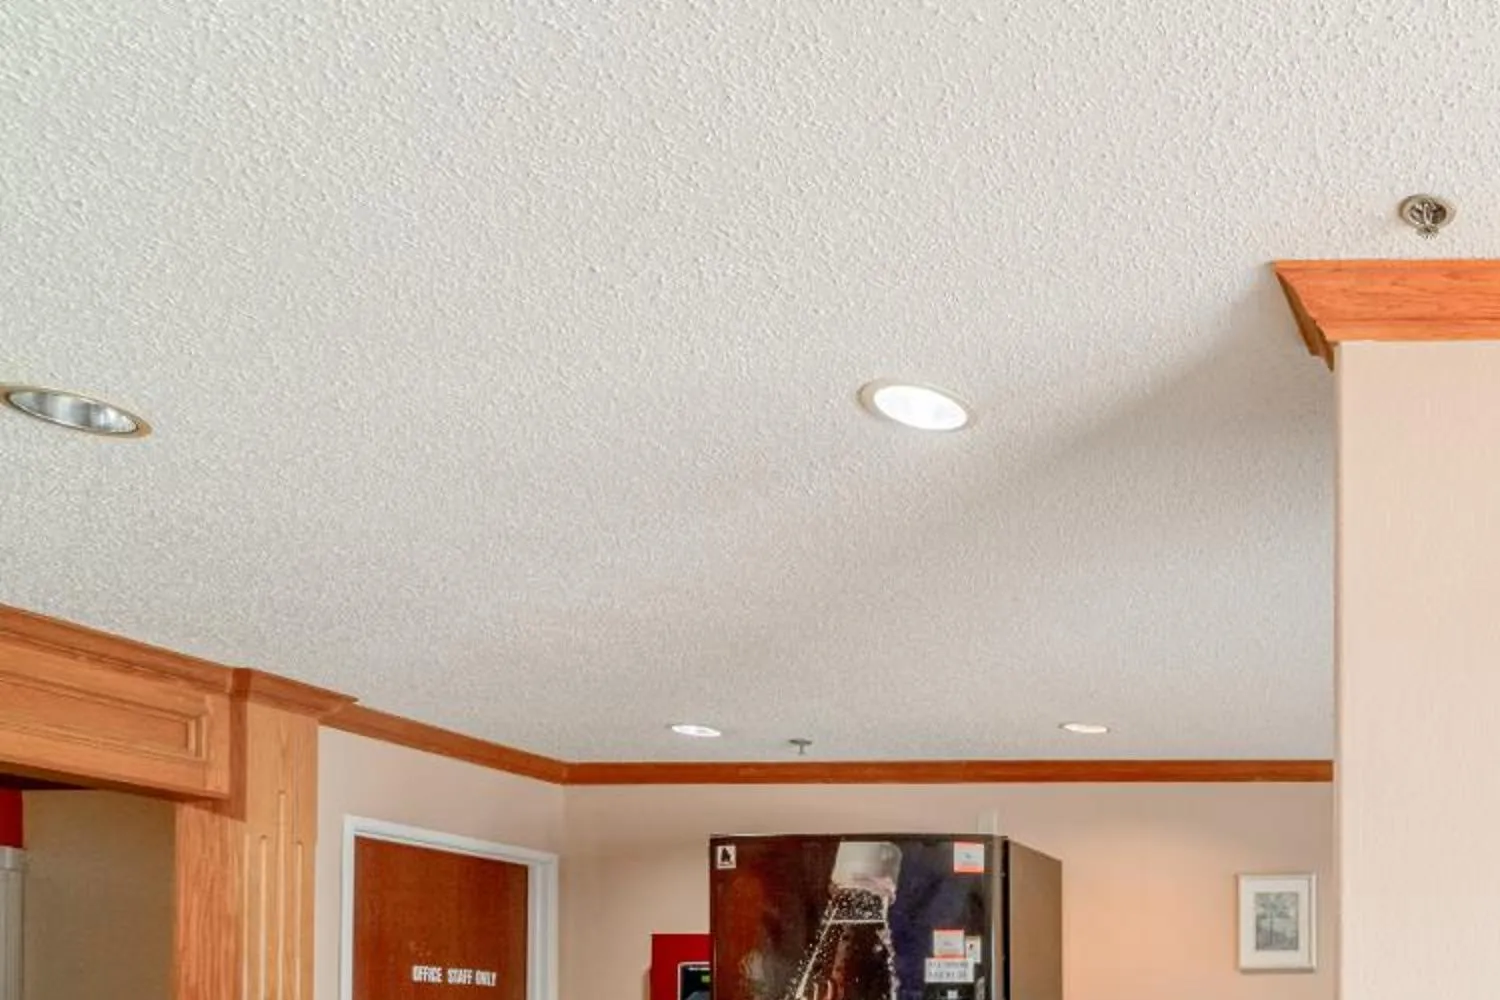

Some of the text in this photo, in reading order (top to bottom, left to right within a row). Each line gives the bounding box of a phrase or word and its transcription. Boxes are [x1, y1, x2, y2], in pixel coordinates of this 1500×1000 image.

[412, 966, 496, 986] OFFICE STAFF ONLY
